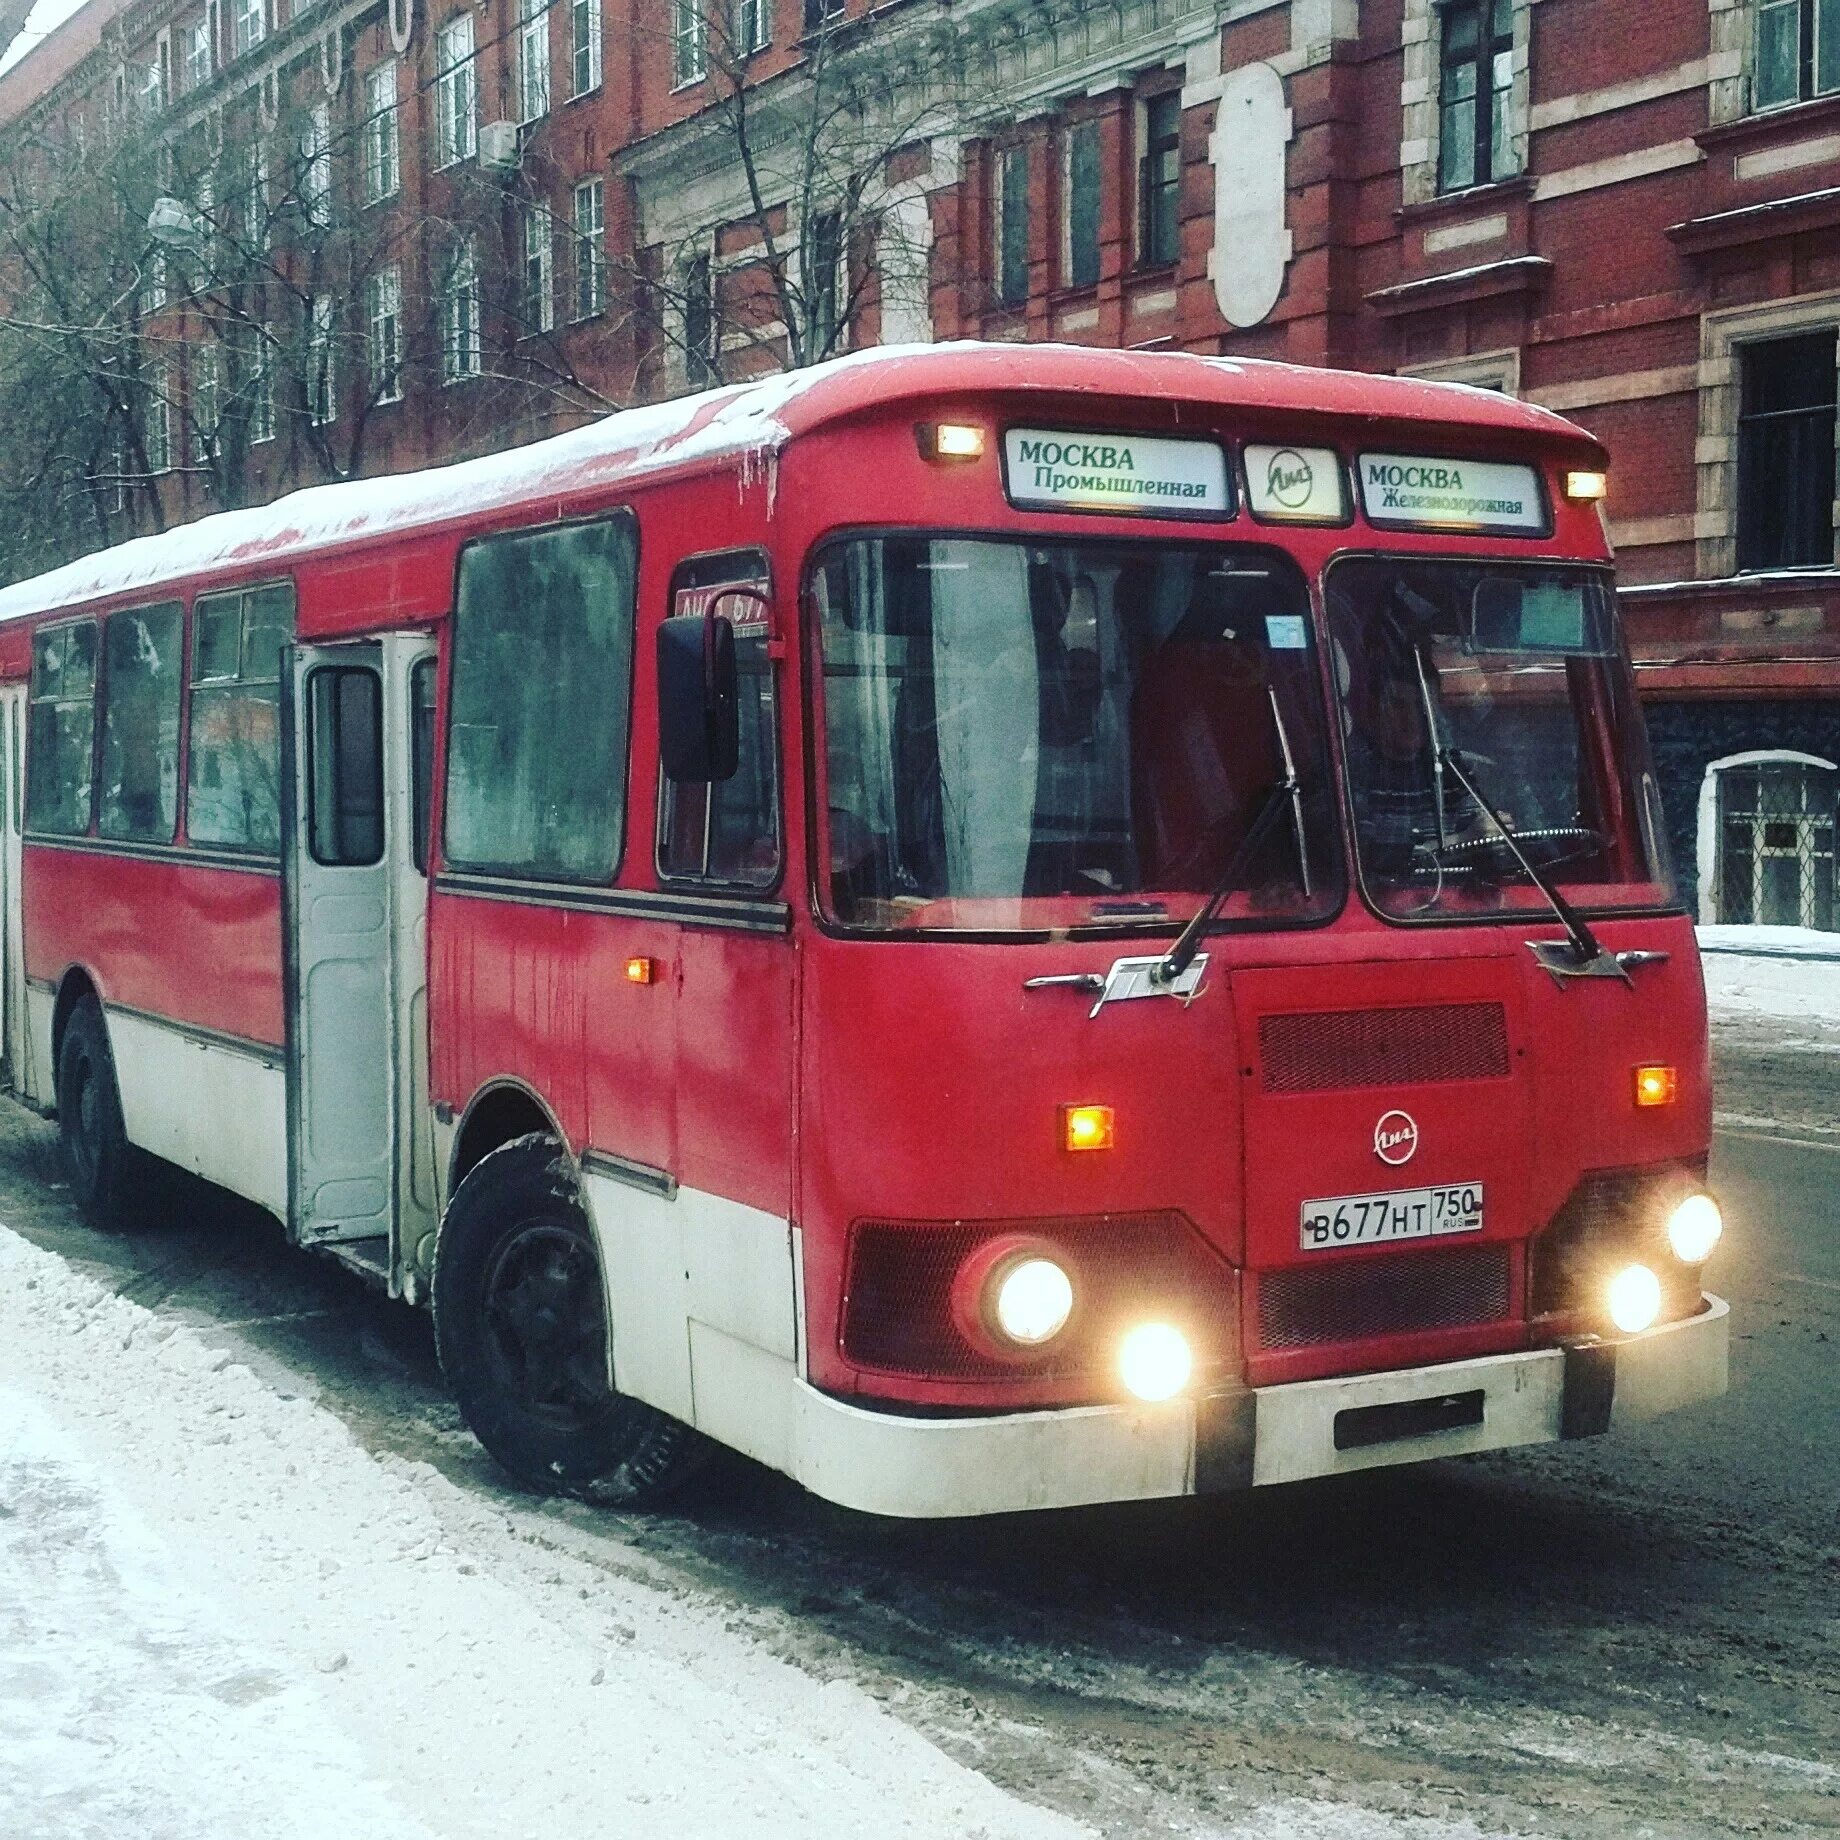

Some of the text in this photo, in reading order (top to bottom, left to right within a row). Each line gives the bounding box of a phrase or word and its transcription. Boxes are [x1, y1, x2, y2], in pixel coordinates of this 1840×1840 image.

[1018, 440, 1135, 471] МОСКВА
[1034, 466, 1208, 498] Промышленная
[1368, 464, 1463, 490] МОСКВА
[1382, 487, 1523, 515] Железнодорожная
[1433, 1188, 1476, 1219] 750
[1442, 1217, 1464, 1229] RUS
